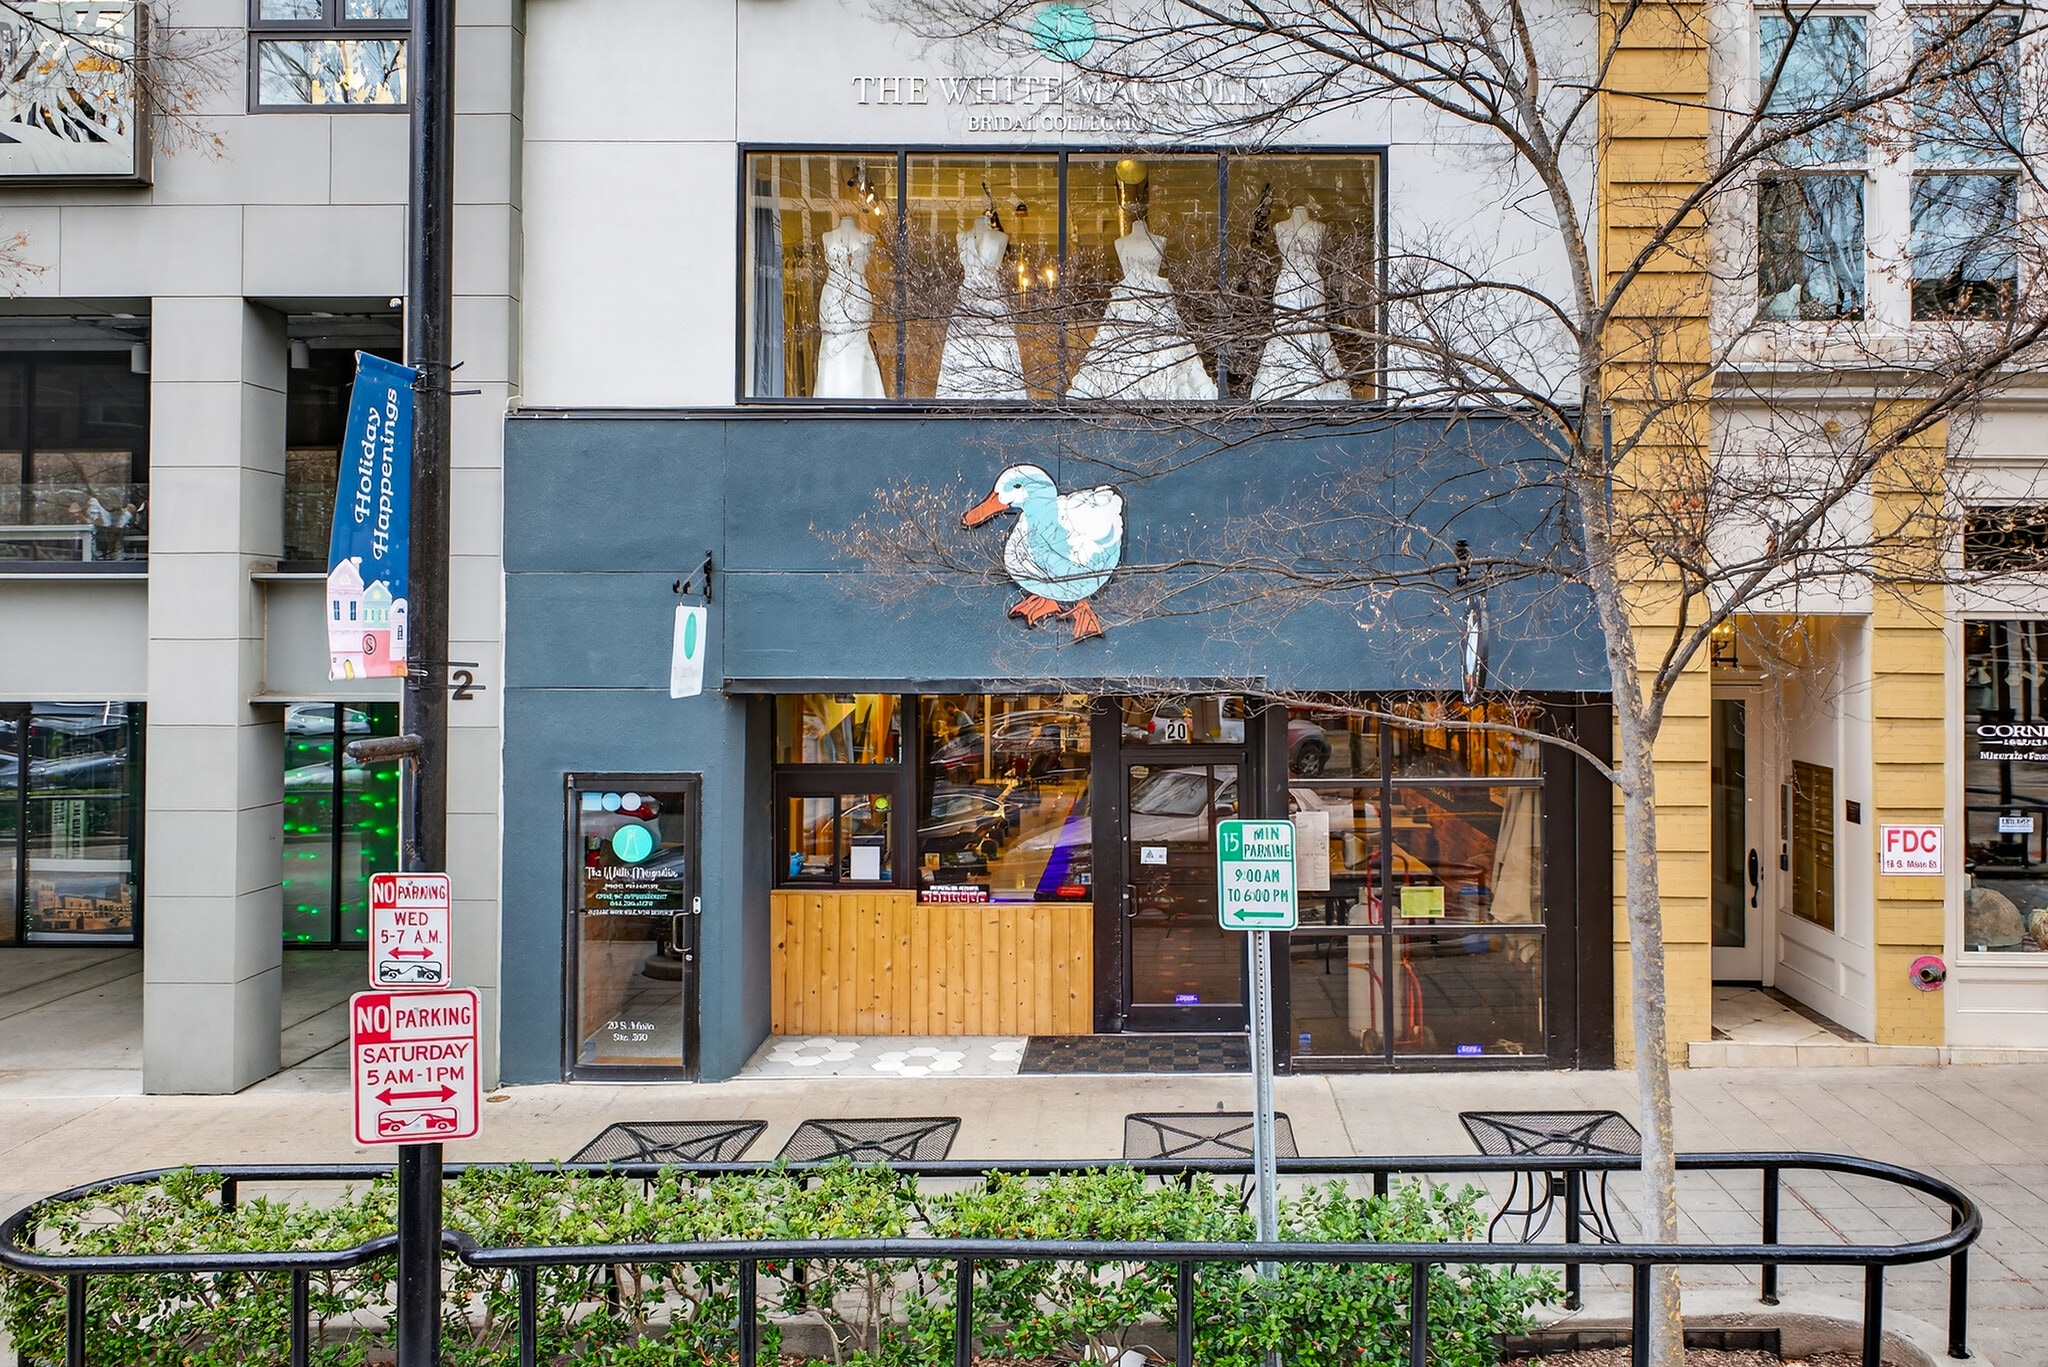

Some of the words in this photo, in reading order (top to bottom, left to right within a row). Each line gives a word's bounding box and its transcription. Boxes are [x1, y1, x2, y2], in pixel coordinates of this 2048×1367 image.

[852, 75, 929, 106] THE
[936, 75, 1063, 106] WHITE
[968, 115, 1037, 132] BRIDAL
[354, 406, 382, 525] Holiday
[373, 387, 399, 562] Happenings
[1167, 723, 1186, 740] 20
[1223, 833, 1239, 852] 15
[1254, 827, 1279, 840] MIN
[1887, 829, 1937, 853] FDC
[1244, 844, 1290, 858] PARKING
[584, 866, 602, 880] The
[1264, 869, 1279, 882] AM
[373, 882, 396, 904] NO
[398, 884, 446, 901] PARKING
[1228, 888, 1241, 902] TO
[1273, 889, 1288, 902] PM
[394, 911, 429, 926] WED
[381, 929, 404, 944] 5-7
[357, 1005, 390, 1034] NO
[395, 1006, 471, 1029] PARKING
[363, 1042, 469, 1064] SATURDAY
